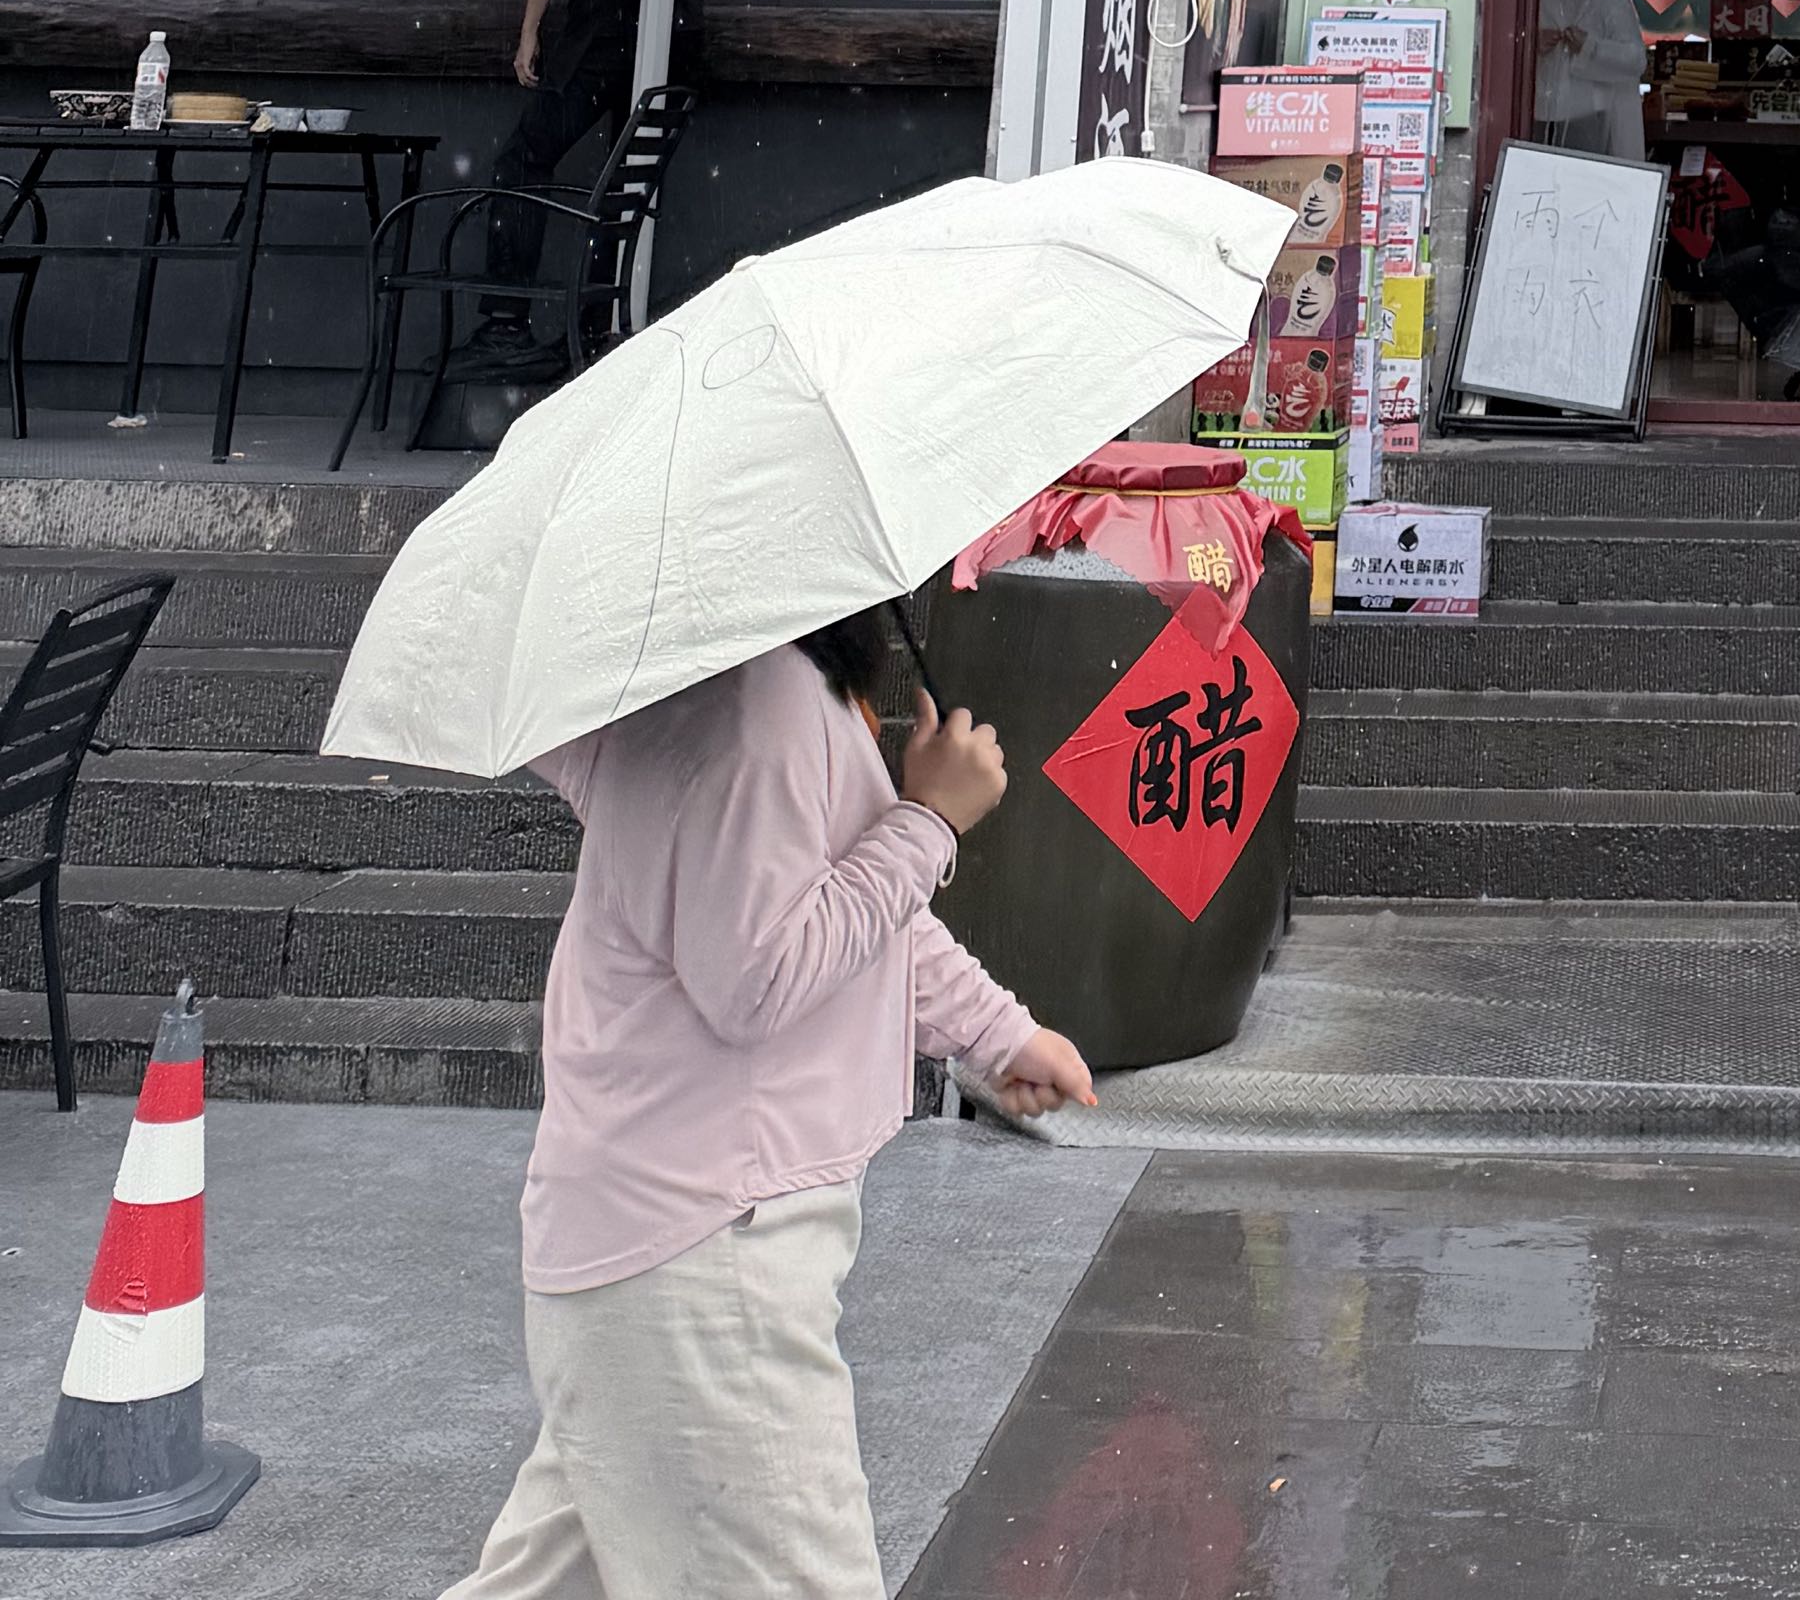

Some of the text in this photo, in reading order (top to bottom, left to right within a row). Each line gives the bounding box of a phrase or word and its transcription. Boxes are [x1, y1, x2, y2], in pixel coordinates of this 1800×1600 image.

[1245, 90, 1330, 118] 维C水
[1245, 118, 1330, 133] VITAMIN C
[1246, 455, 1308, 483] C水
[1295, 486, 1307, 501] C
[1182, 537, 1235, 594] 醋
[1351, 557, 1466, 576] 外星人电解质水
[1354, 577, 1460, 587] ALIENERGY
[1124, 655, 1264, 835] 醋
